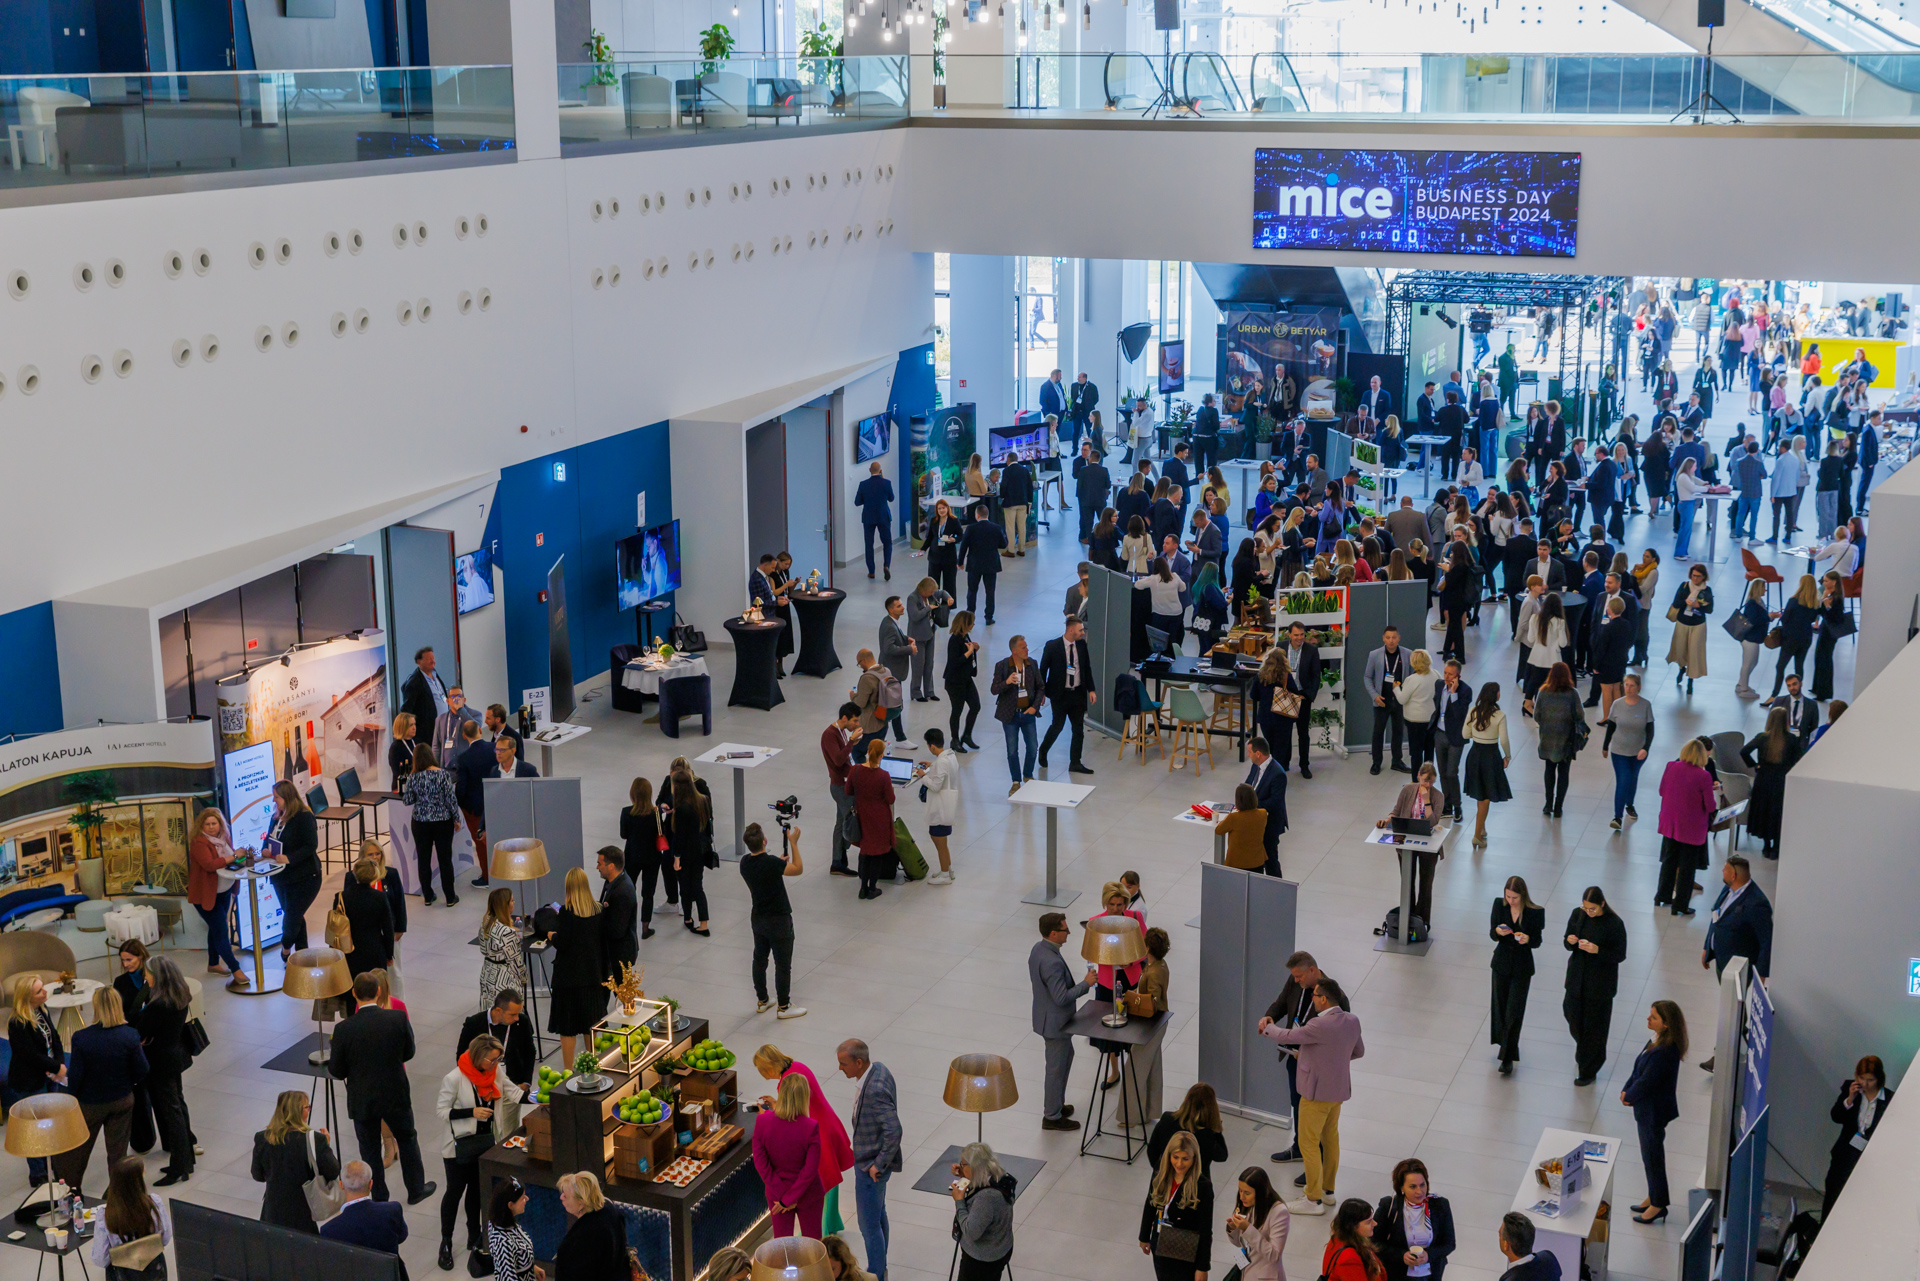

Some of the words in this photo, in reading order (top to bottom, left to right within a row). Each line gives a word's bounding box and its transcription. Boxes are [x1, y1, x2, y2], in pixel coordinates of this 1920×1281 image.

[1279, 172, 1393, 219] mice
[1416, 188, 1507, 204] BUSINESS
[1516, 190, 1552, 205] DAY
[1415, 206, 1502, 221] BUDAPEST
[1508, 207, 1551, 222] 2024
[1237, 325, 1271, 334] URBAN
[1290, 325, 1327, 336] BETYÁR
[886, 376, 890, 387] 6
[893, 403, 898, 415] F
[478, 504, 485, 518] 7
[491, 539, 498, 554] F
[528, 691, 545, 699] E-23
[42, 746, 92, 762] KAPUJA
